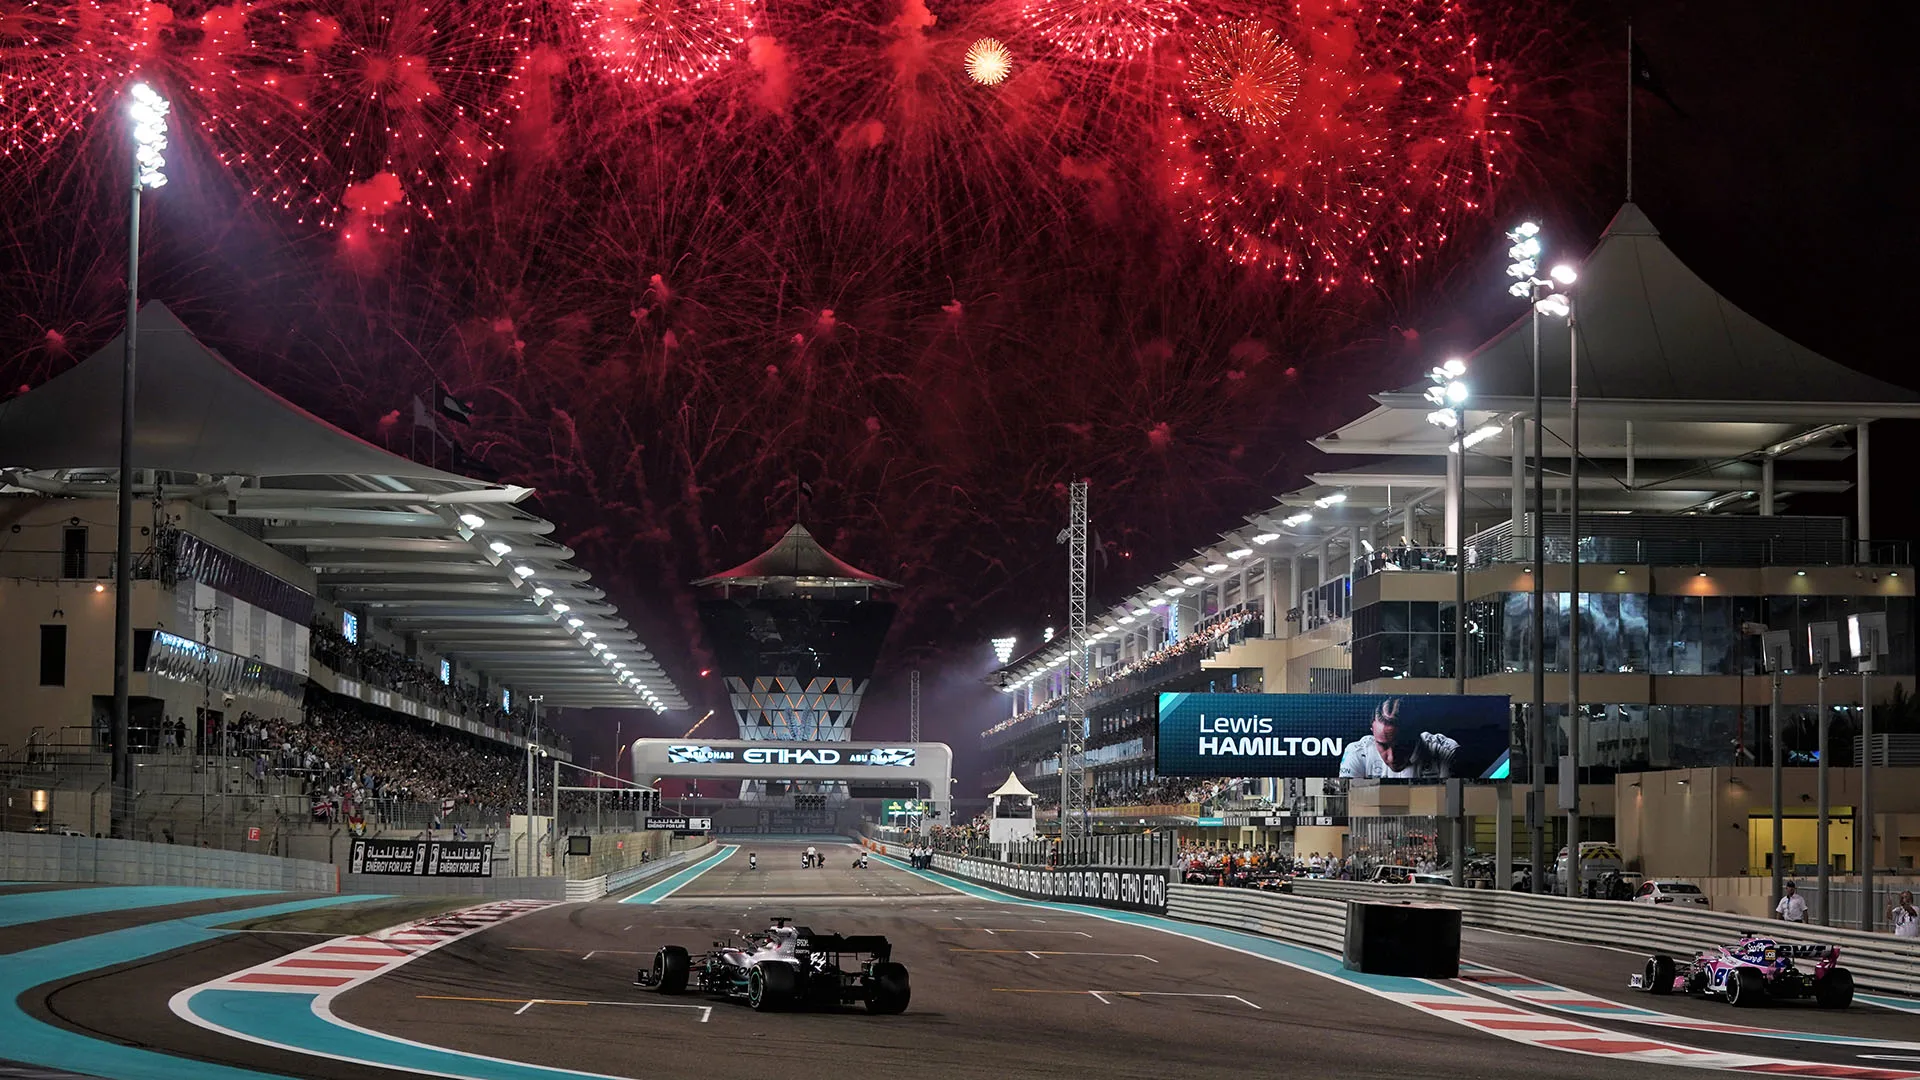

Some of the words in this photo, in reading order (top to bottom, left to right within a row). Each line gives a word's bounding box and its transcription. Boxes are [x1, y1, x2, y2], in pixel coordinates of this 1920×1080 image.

[1200, 714, 1273, 733] Lewis
[1199, 737, 1342, 756] HAMILTON
[707, 751, 734, 760] DHABI
[743, 748, 841, 765] ETIHAD
[849, 754, 868, 762] ABU
[365, 861, 388, 873] ENERGY
[388, 861, 401, 873] FOR
[400, 861, 412, 873] LIFE
[439, 862, 459, 873] ENERGY
[459, 862, 471, 873] FOR
[469, 863, 480, 873] LIFE
[1101, 872, 1120, 900] ETIHAD
[1121, 873, 1141, 904] ETIHAD
[1143, 874, 1165, 907] ETIHAD
